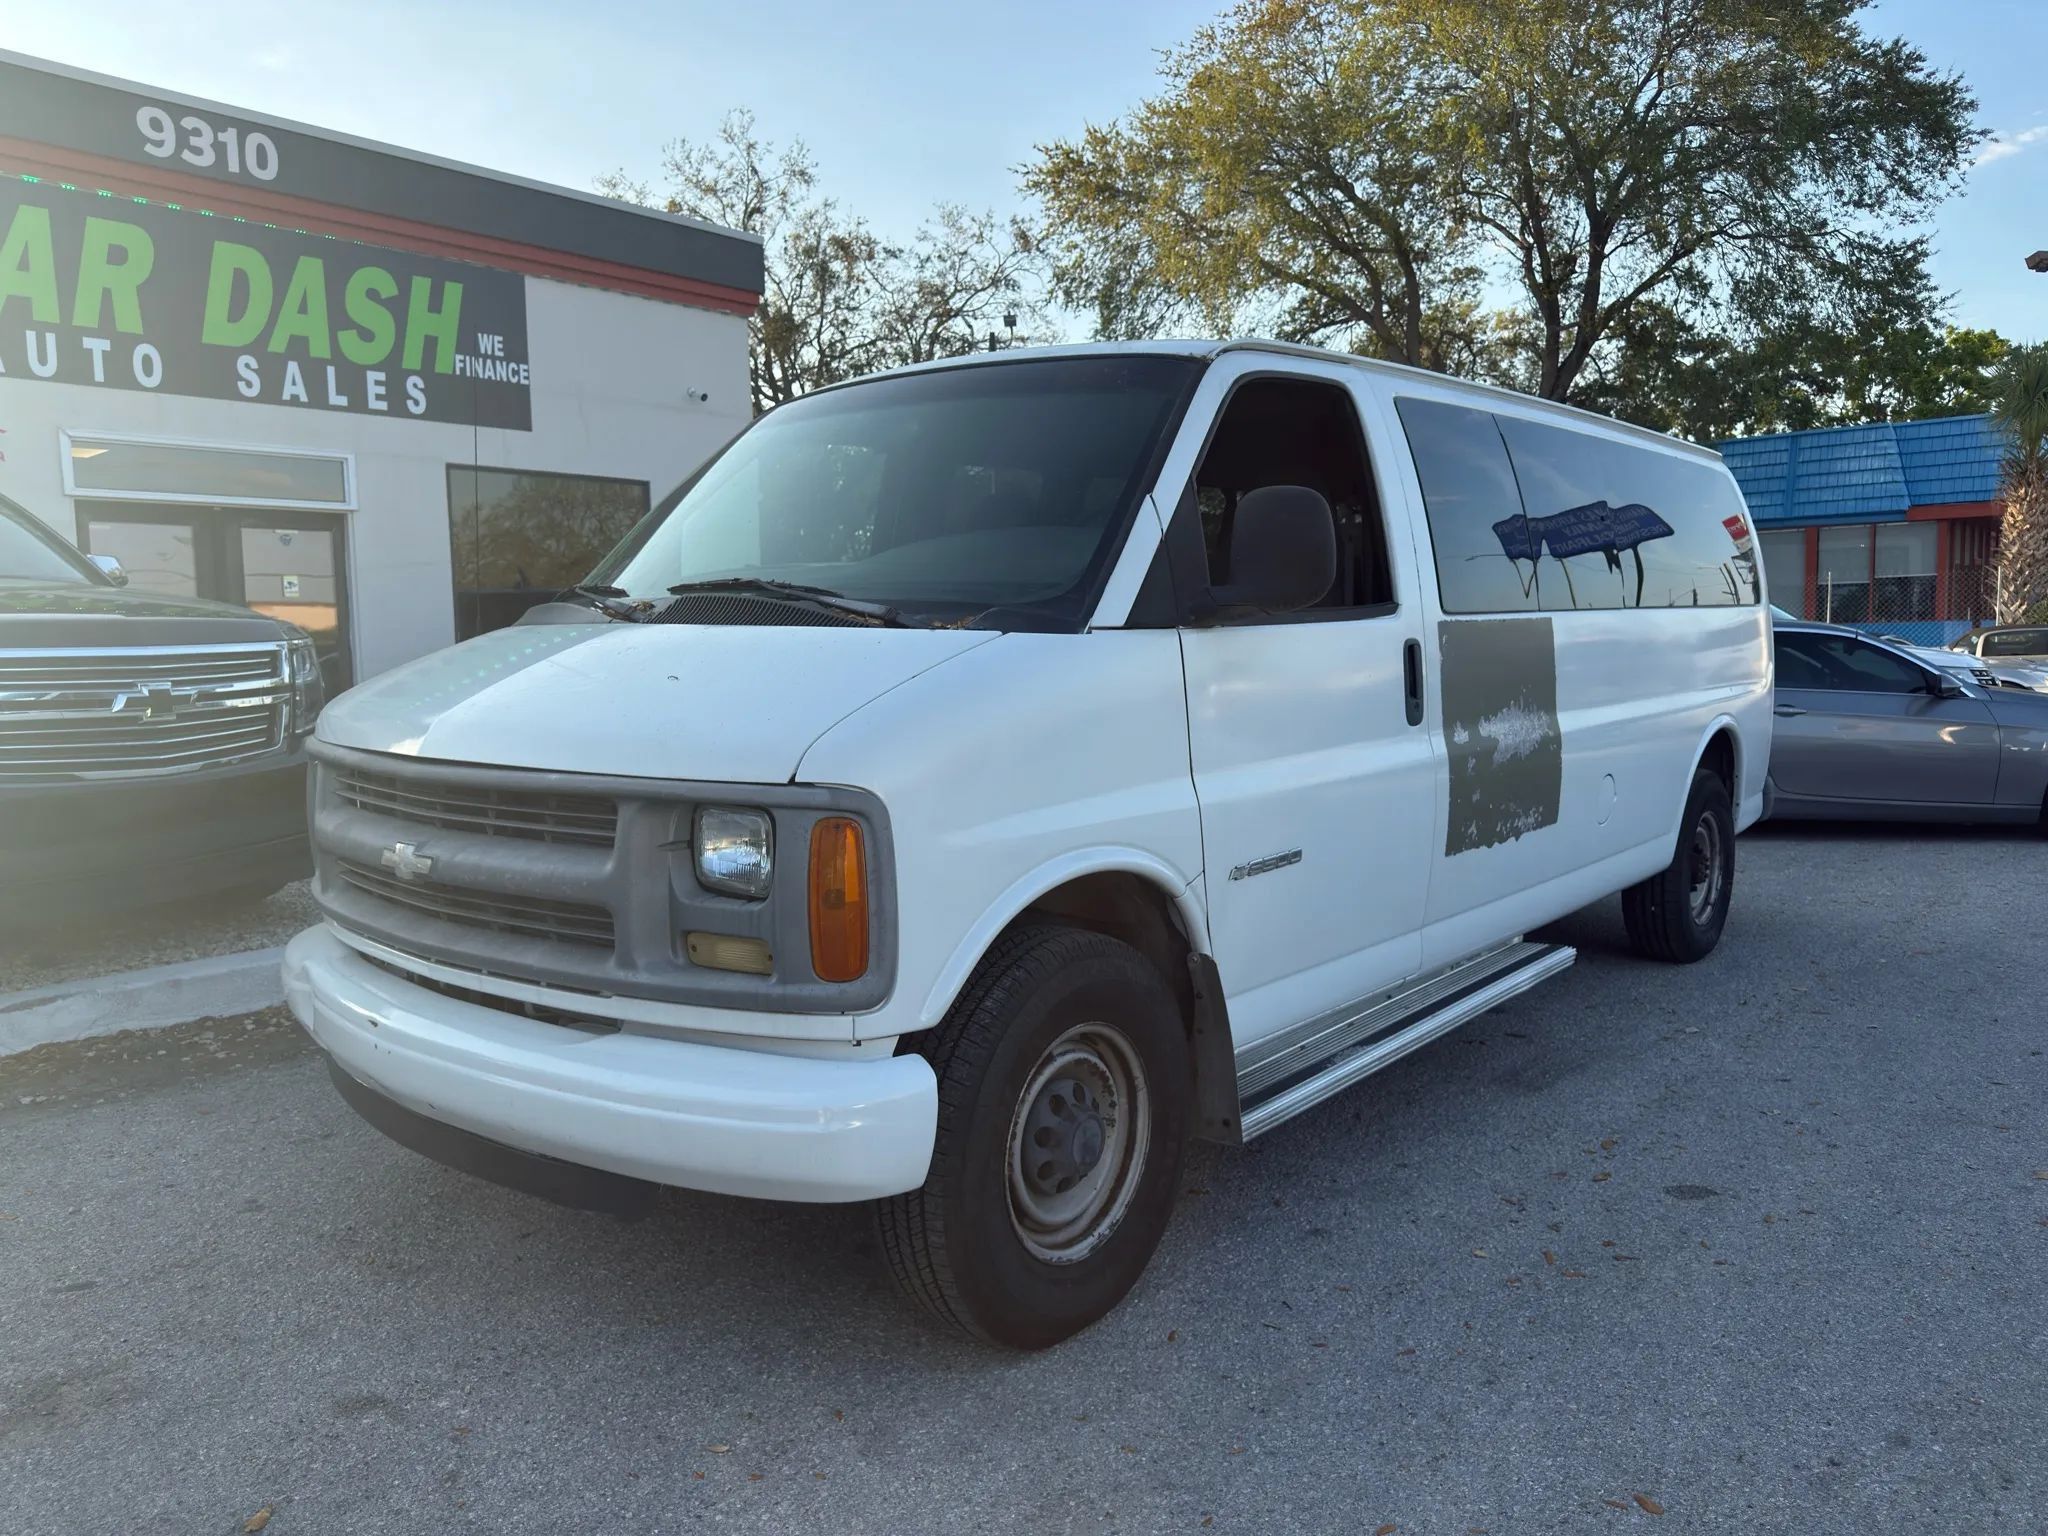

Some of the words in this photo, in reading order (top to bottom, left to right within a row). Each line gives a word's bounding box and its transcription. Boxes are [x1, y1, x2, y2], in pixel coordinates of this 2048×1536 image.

[136, 106, 279, 181] 9310
[202, 240, 464, 375] DASH
[477, 332, 504, 357] WE
[0, 329, 163, 388] UTO
[236, 355, 428, 415] SALES
[455, 353, 530, 385] FINANCE
